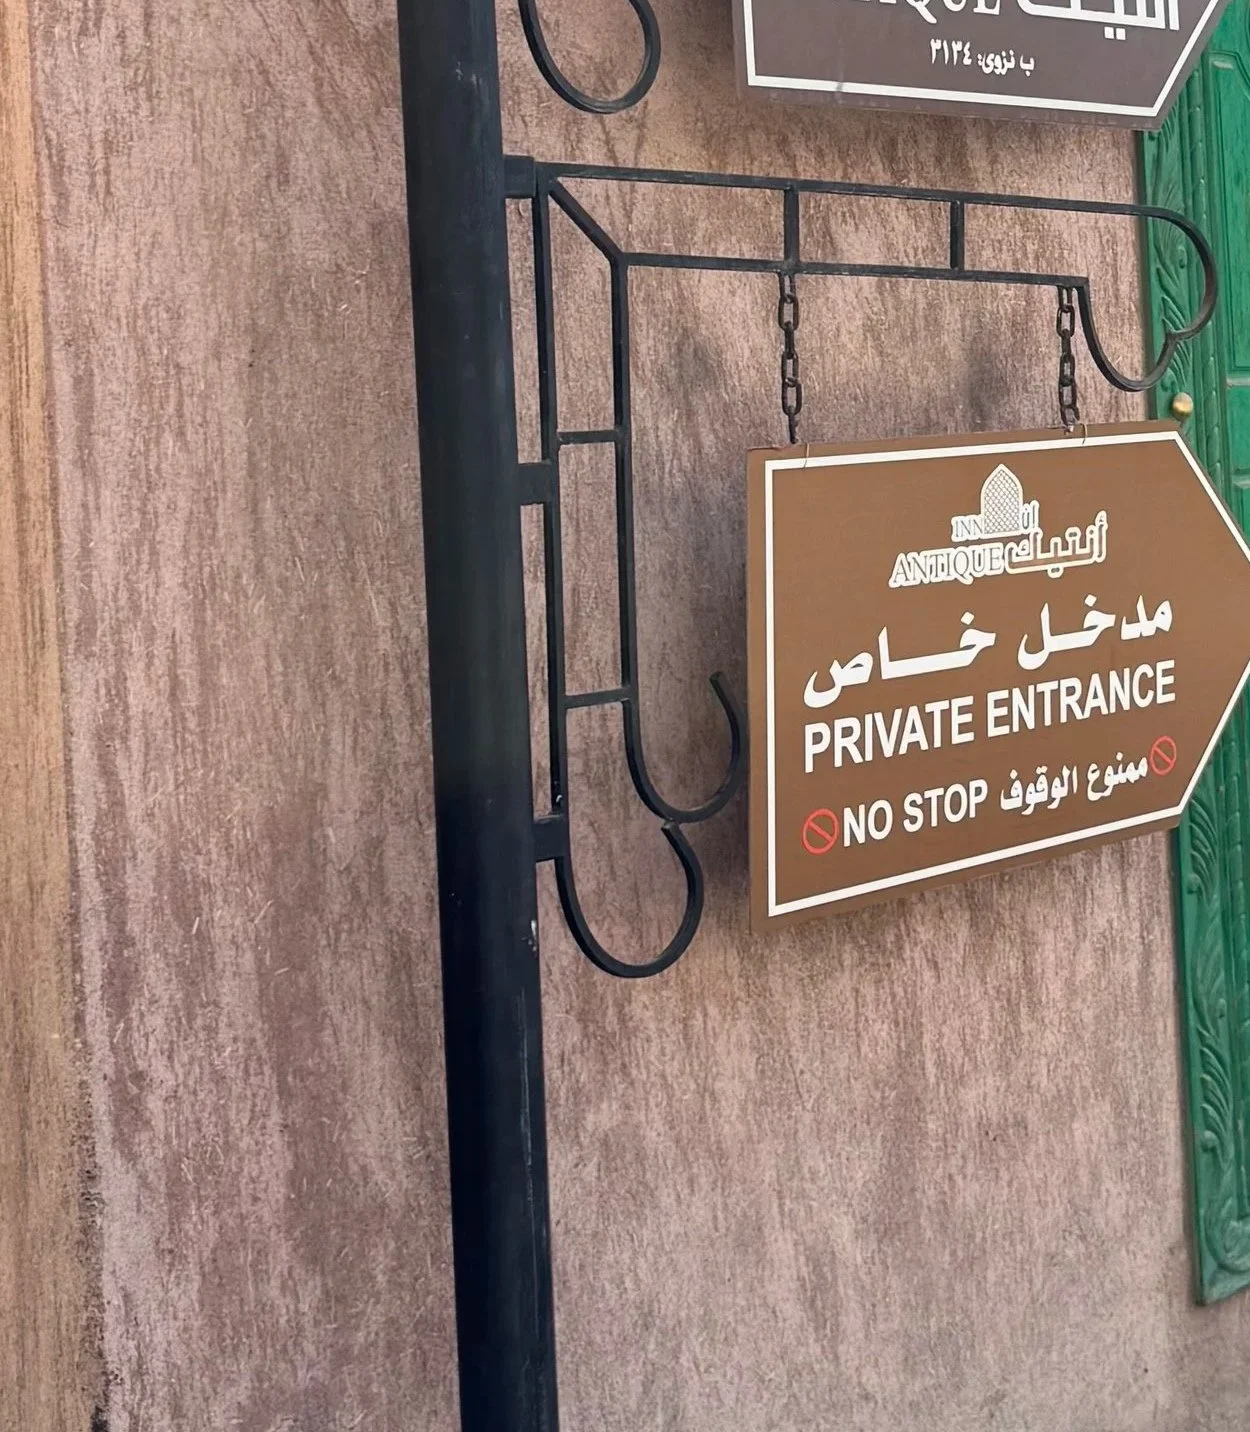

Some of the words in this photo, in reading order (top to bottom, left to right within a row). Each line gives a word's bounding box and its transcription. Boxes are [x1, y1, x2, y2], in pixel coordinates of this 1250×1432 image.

[952, 515, 986, 541] INN
[1005, 513, 1107, 576] أنتيك
[891, 544, 1004, 586] ANTIQUE
[803, 611, 997, 709] خاص
[1017, 594, 1175, 671] مدخل
[803, 696, 975, 773] PRIVATE
[987, 659, 1176, 738] ENTRANCE
[1000, 765, 1078, 815] الوقوف
[1087, 752, 1149, 801] ممنوع
[843, 799, 893, 847] NO
[903, 779, 988, 833] STOP
